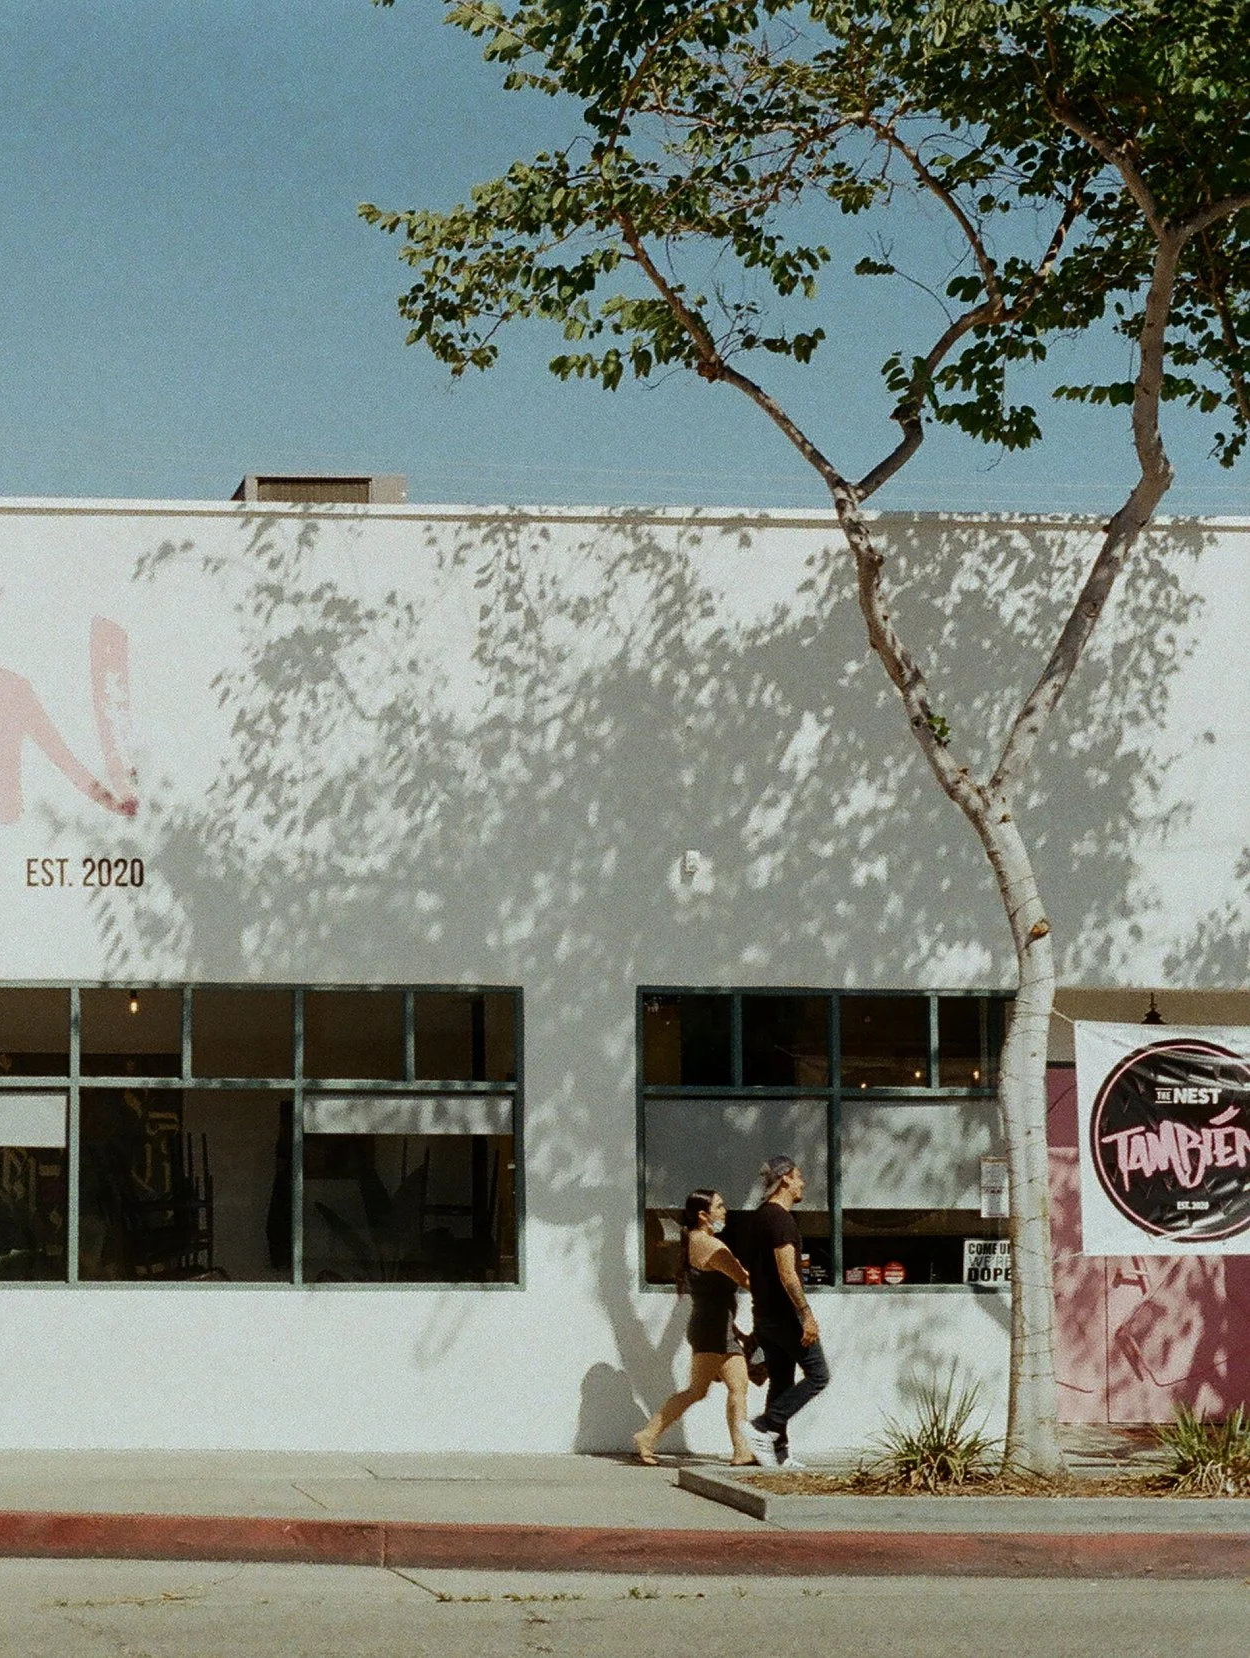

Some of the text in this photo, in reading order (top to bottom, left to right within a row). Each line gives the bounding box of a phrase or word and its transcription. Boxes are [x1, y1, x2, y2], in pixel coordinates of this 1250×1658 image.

[26, 859, 145, 888] EST. 2020
[1157, 1088, 1222, 1104] THE NEST
[968, 1243, 997, 1255] COME
[968, 1268, 1012, 1282] DOPE
